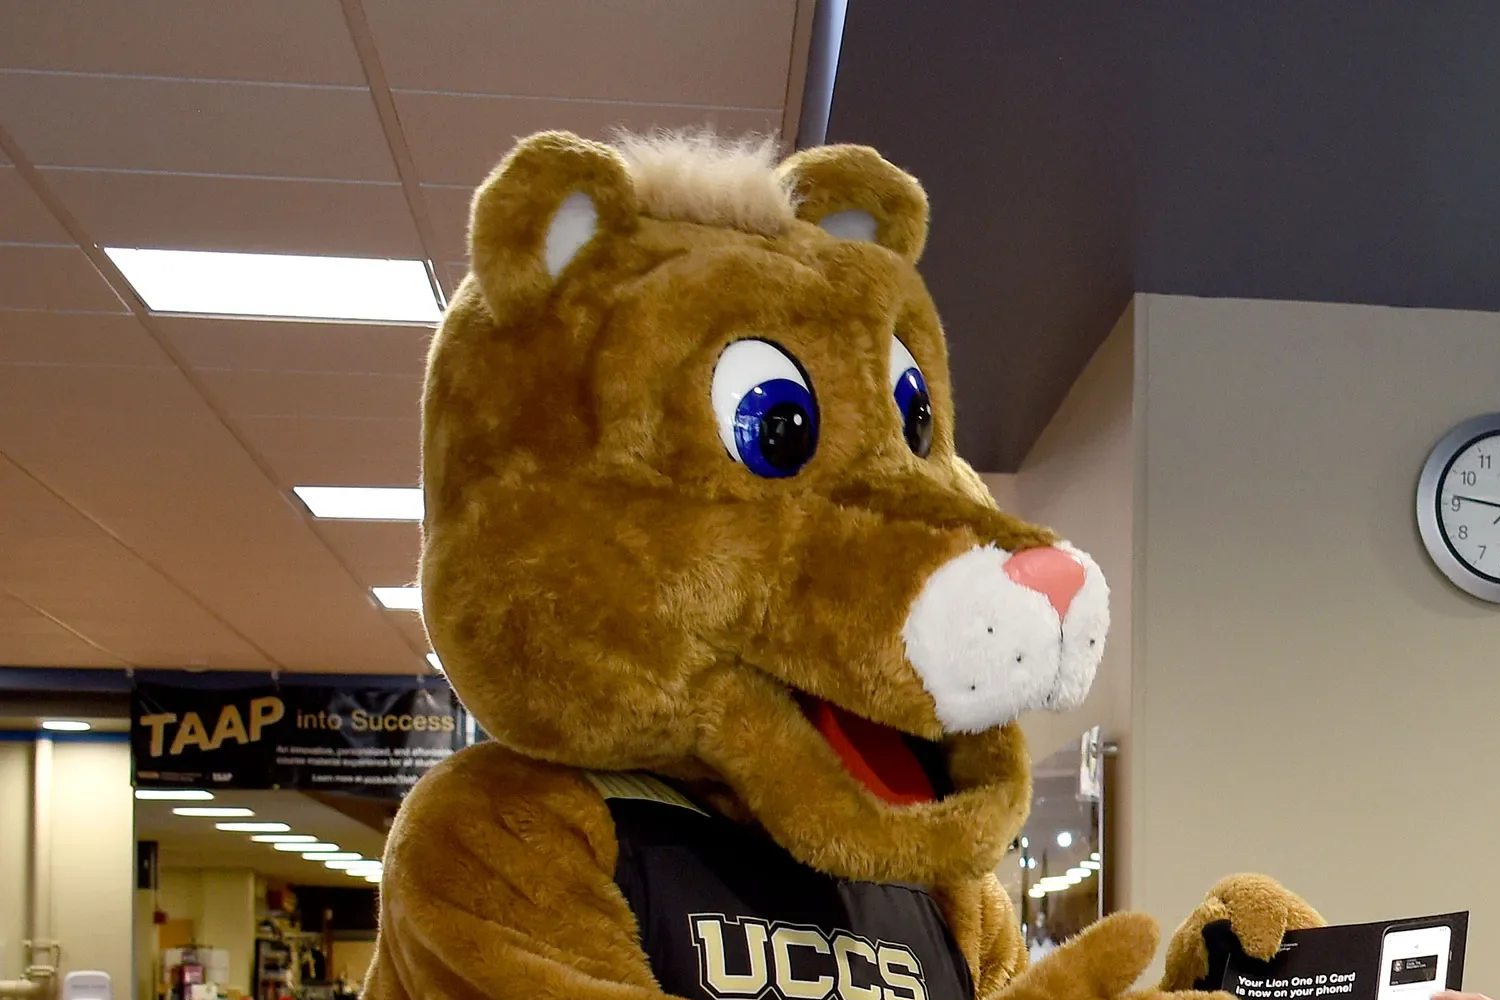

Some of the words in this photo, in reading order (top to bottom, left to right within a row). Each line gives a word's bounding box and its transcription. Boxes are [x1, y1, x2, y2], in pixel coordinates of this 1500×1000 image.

[1478, 455, 1491, 469] 11
[1461, 471, 1476, 486] 10
[1451, 497, 1461, 512] 9
[1458, 525, 1469, 540] 8
[1477, 545, 1487, 560] 7
[140, 696, 285, 757] TAAP
[296, 709, 343, 729] into
[351, 708, 456, 732] Success
[1238, 975, 1263, 987] Your
[1266, 979, 1288, 988] Lion
[1291, 977, 1313, 986] One
[1315, 975, 1327, 984] ID
[1329, 972, 1356, 983] Card
[1248, 989, 1271, 997] now
[1274, 989, 1287, 997] on
[1290, 988, 1314, 998] your
[1316, 983, 1352, 996] phone!
